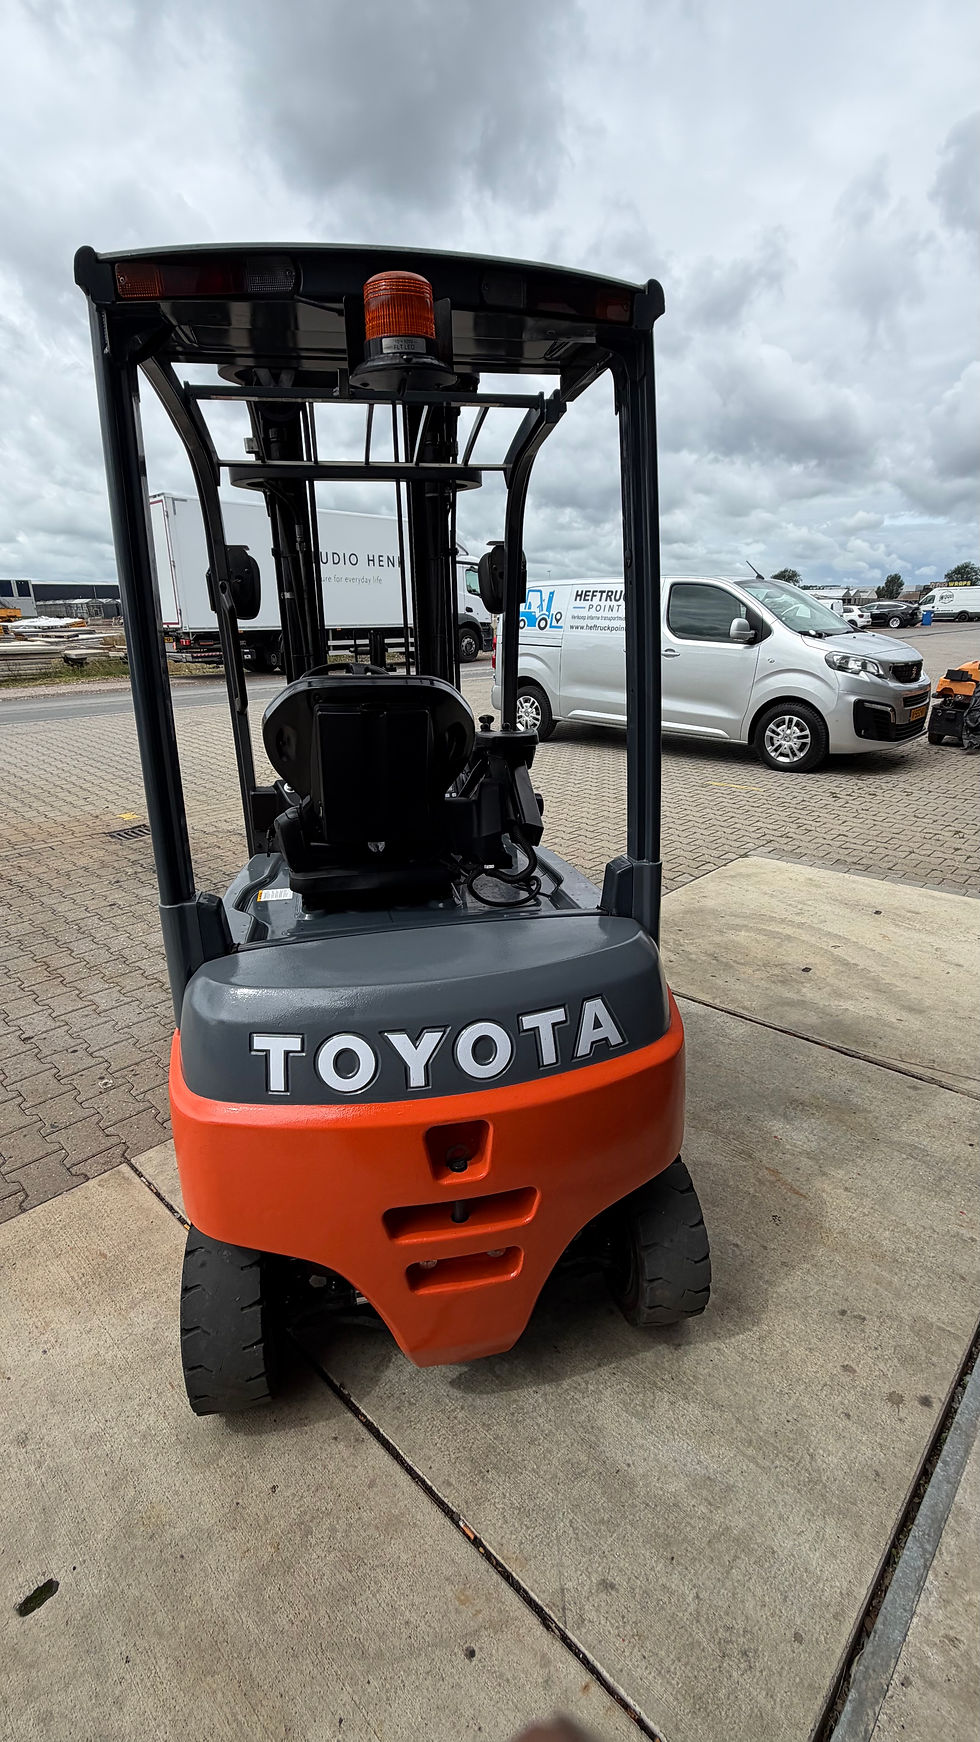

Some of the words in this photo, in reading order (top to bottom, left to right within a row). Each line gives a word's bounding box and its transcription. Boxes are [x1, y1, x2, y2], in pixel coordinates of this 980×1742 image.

[344, 576, 371, 584] everyday
[372, 575, 383, 584] life
[588, 604, 621, 612] POINT
[250, 994, 628, 1095] TOYOTA
